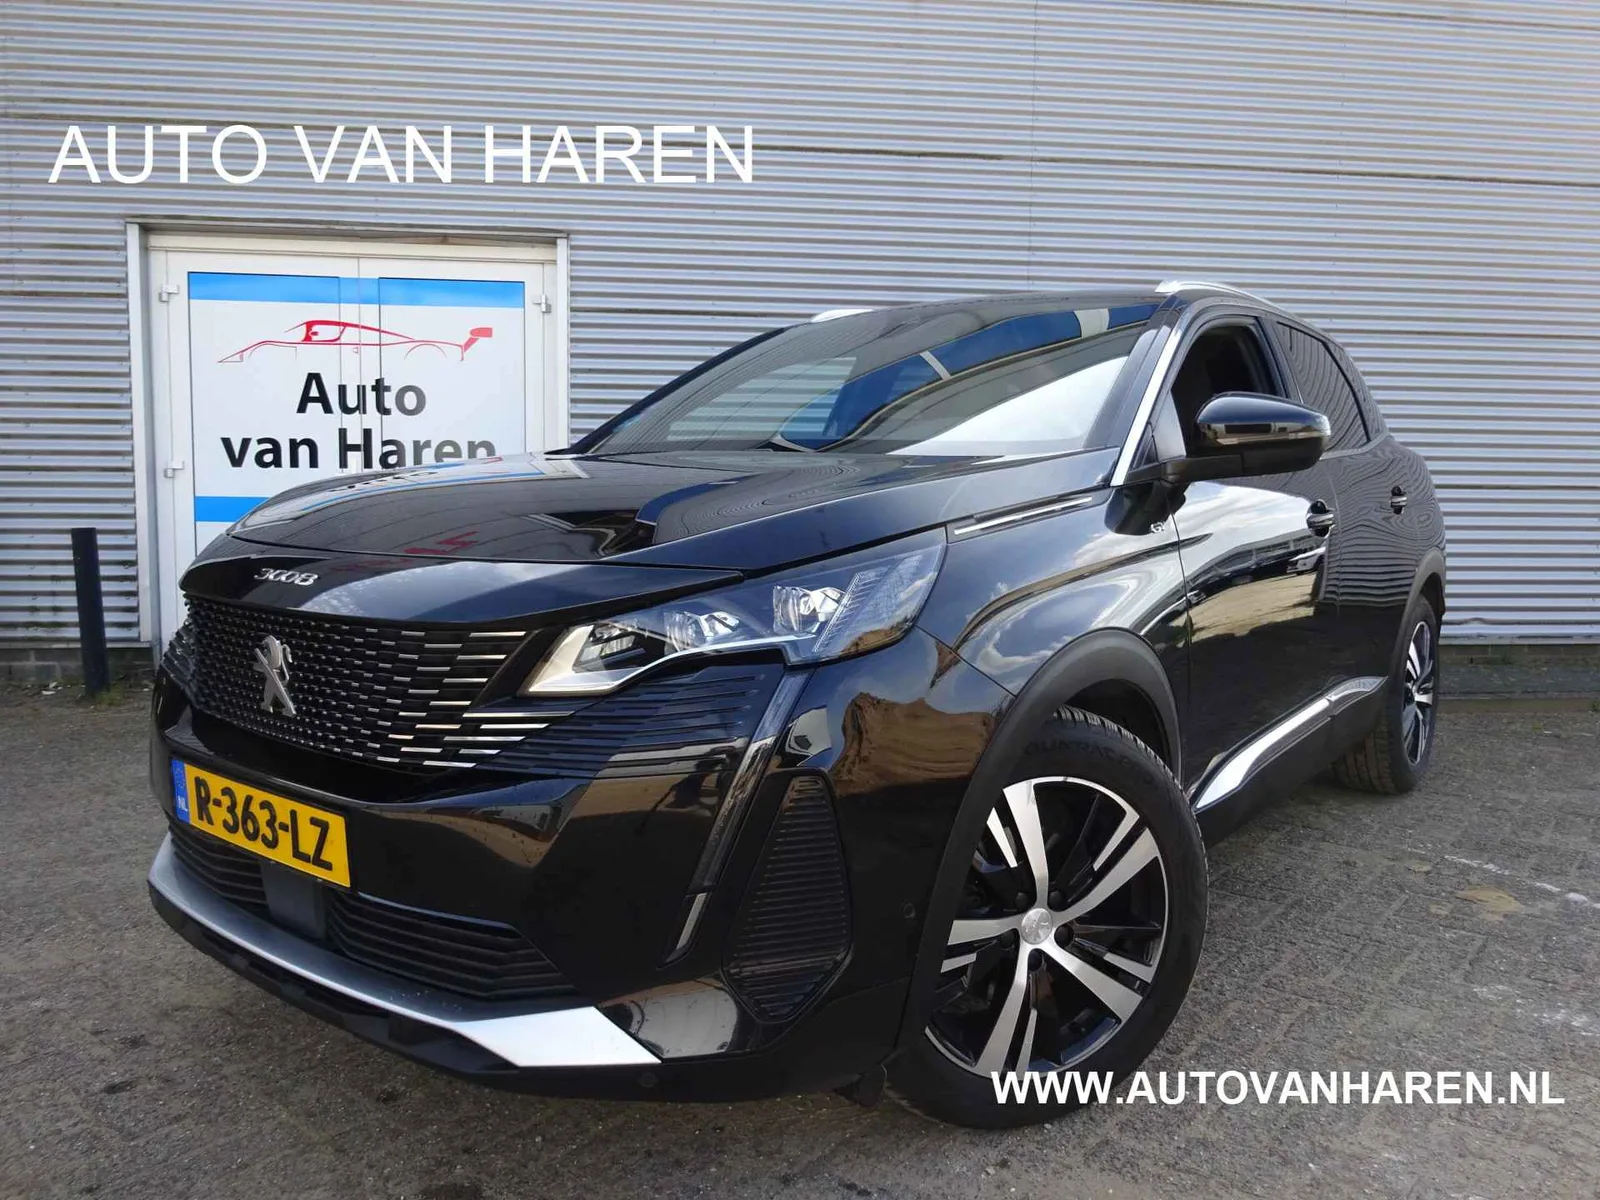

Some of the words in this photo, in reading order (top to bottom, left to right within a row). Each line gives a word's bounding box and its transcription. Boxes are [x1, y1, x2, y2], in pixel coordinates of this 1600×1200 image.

[296, 372, 427, 416] Auto
[220, 436, 319, 469] van
[338, 427, 496, 470] Haren
[253, 567, 319, 586] 3008
[194, 776, 333, 871] R-363-LZ
